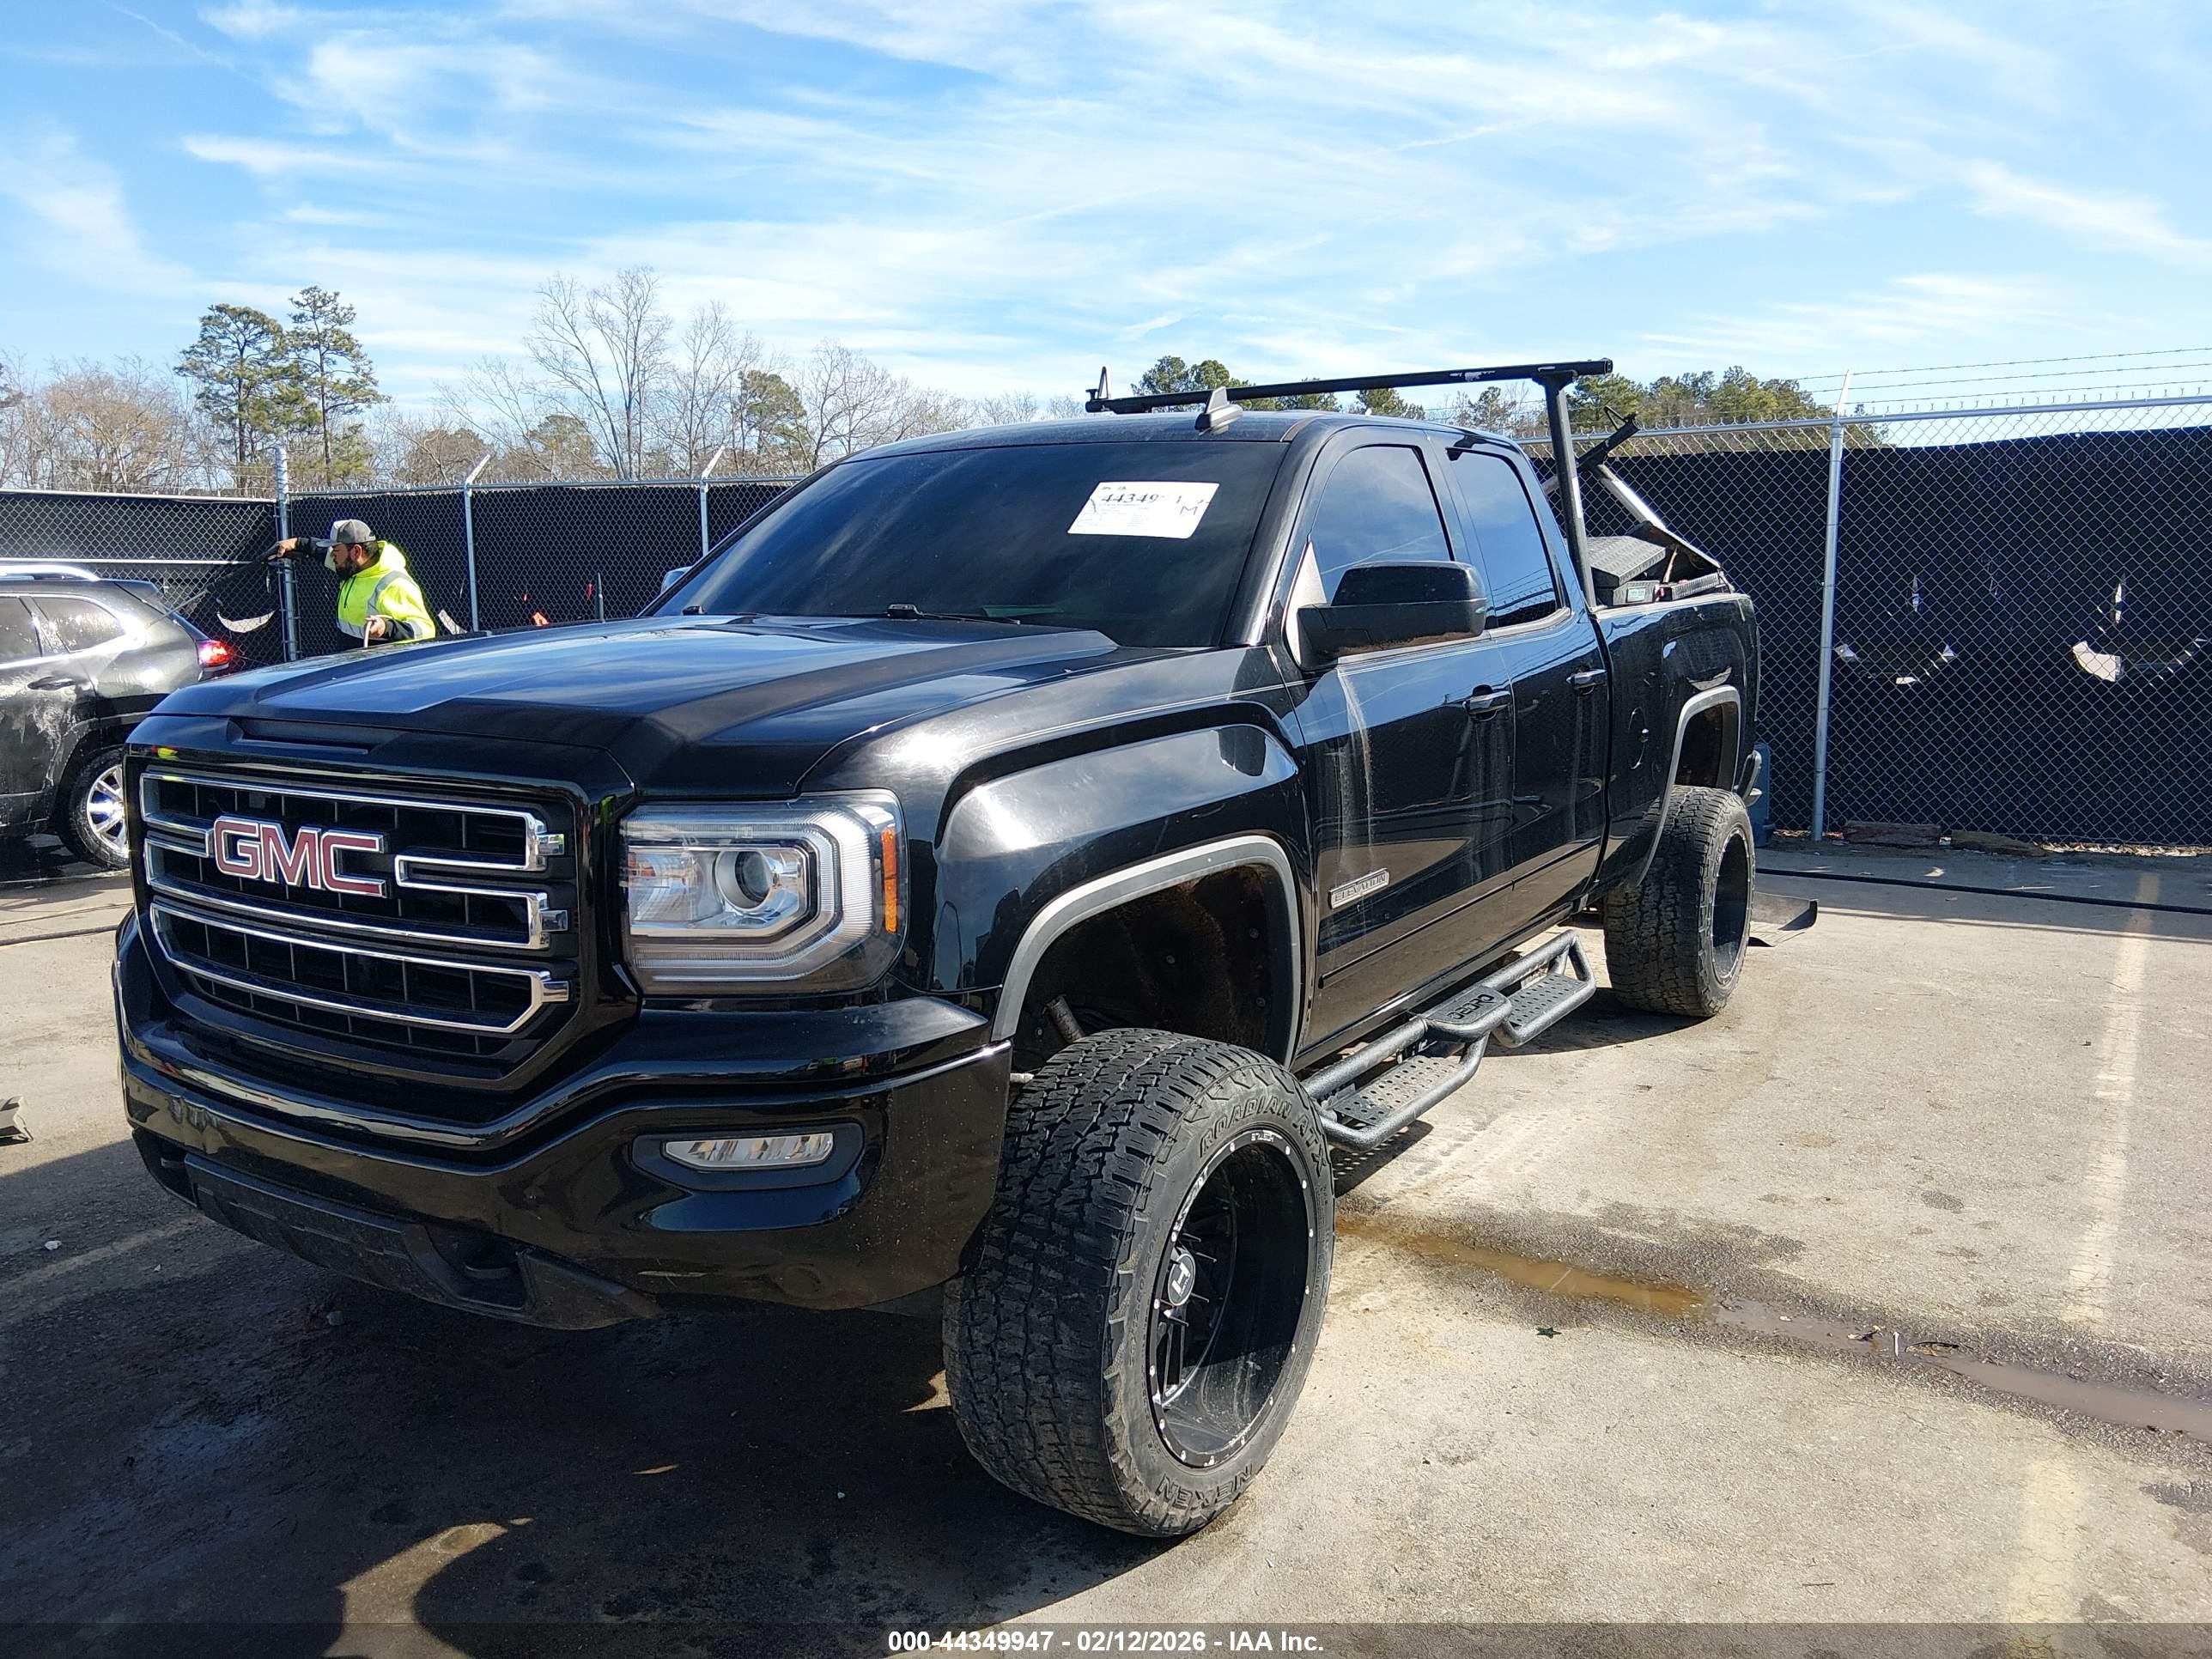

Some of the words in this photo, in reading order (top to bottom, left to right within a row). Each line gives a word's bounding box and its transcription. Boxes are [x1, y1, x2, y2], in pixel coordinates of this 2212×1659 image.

[214, 816, 386, 898] GMC
[1200, 1095, 1292, 1158] ROADIAN
[1154, 1462, 1254, 1510] NEXEN
